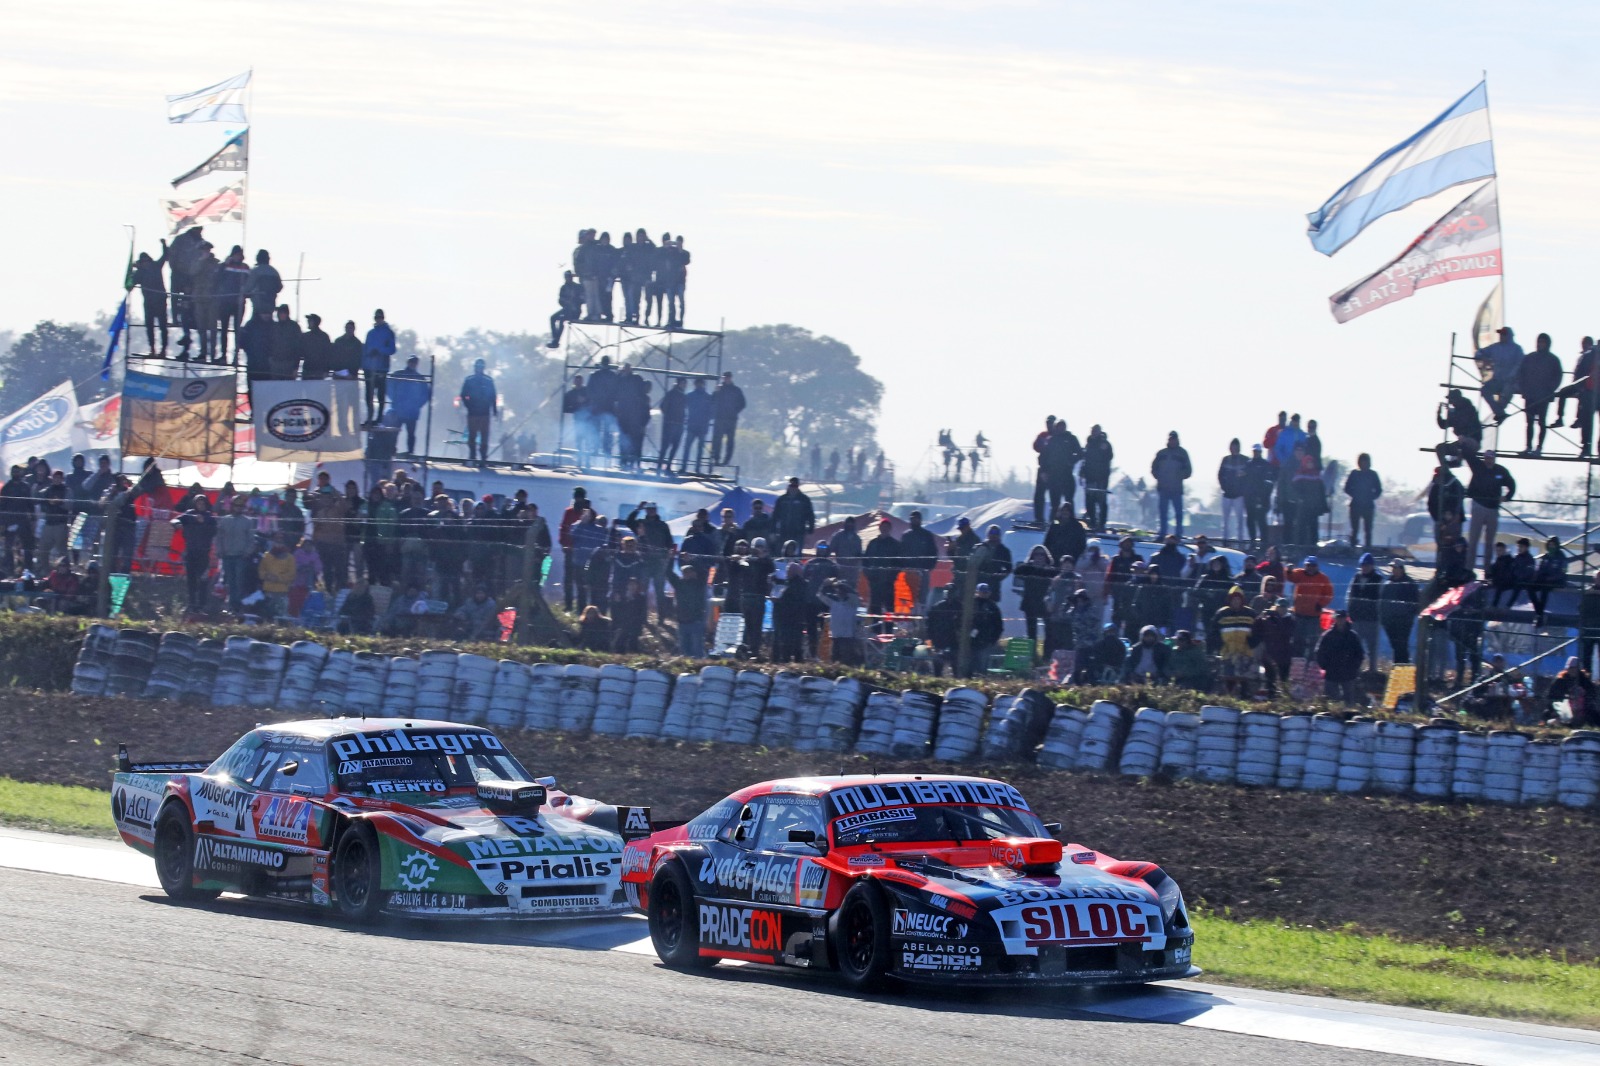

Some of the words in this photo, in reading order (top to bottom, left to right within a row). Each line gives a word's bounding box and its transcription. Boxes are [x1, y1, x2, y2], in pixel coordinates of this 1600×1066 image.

[332, 728, 502, 760] philagro
[252, 751, 282, 787] 7
[361, 757, 412, 768] ALTAMIRANO
[367, 780, 446, 795] TRENTO
[830, 781, 1030, 815] MULTIBANDAS
[126, 793, 152, 822] AGL
[260, 797, 312, 830] AMA
[625, 807, 650, 829] FAE
[838, 808, 914, 828] TRABASIL
[259, 827, 306, 840] LUBRICANTS
[689, 824, 719, 839] IVECO
[213, 843, 284, 868] ALTAMIRANO
[990, 846, 1027, 866] WEGA
[501, 857, 612, 881] Prialis
[699, 852, 798, 900] waterplast
[441, 897, 447, 905] &
[451, 895, 466, 908] J.M
[531, 898, 600, 908] COMBUSTIBLES
[995, 886, 1148, 908] BONANO
[699, 905, 782, 951] PRADECON
[1020, 903, 1146, 940] SILOC
[902, 942, 980, 954] ABELARDO
[903, 953, 982, 966] RACIGH
